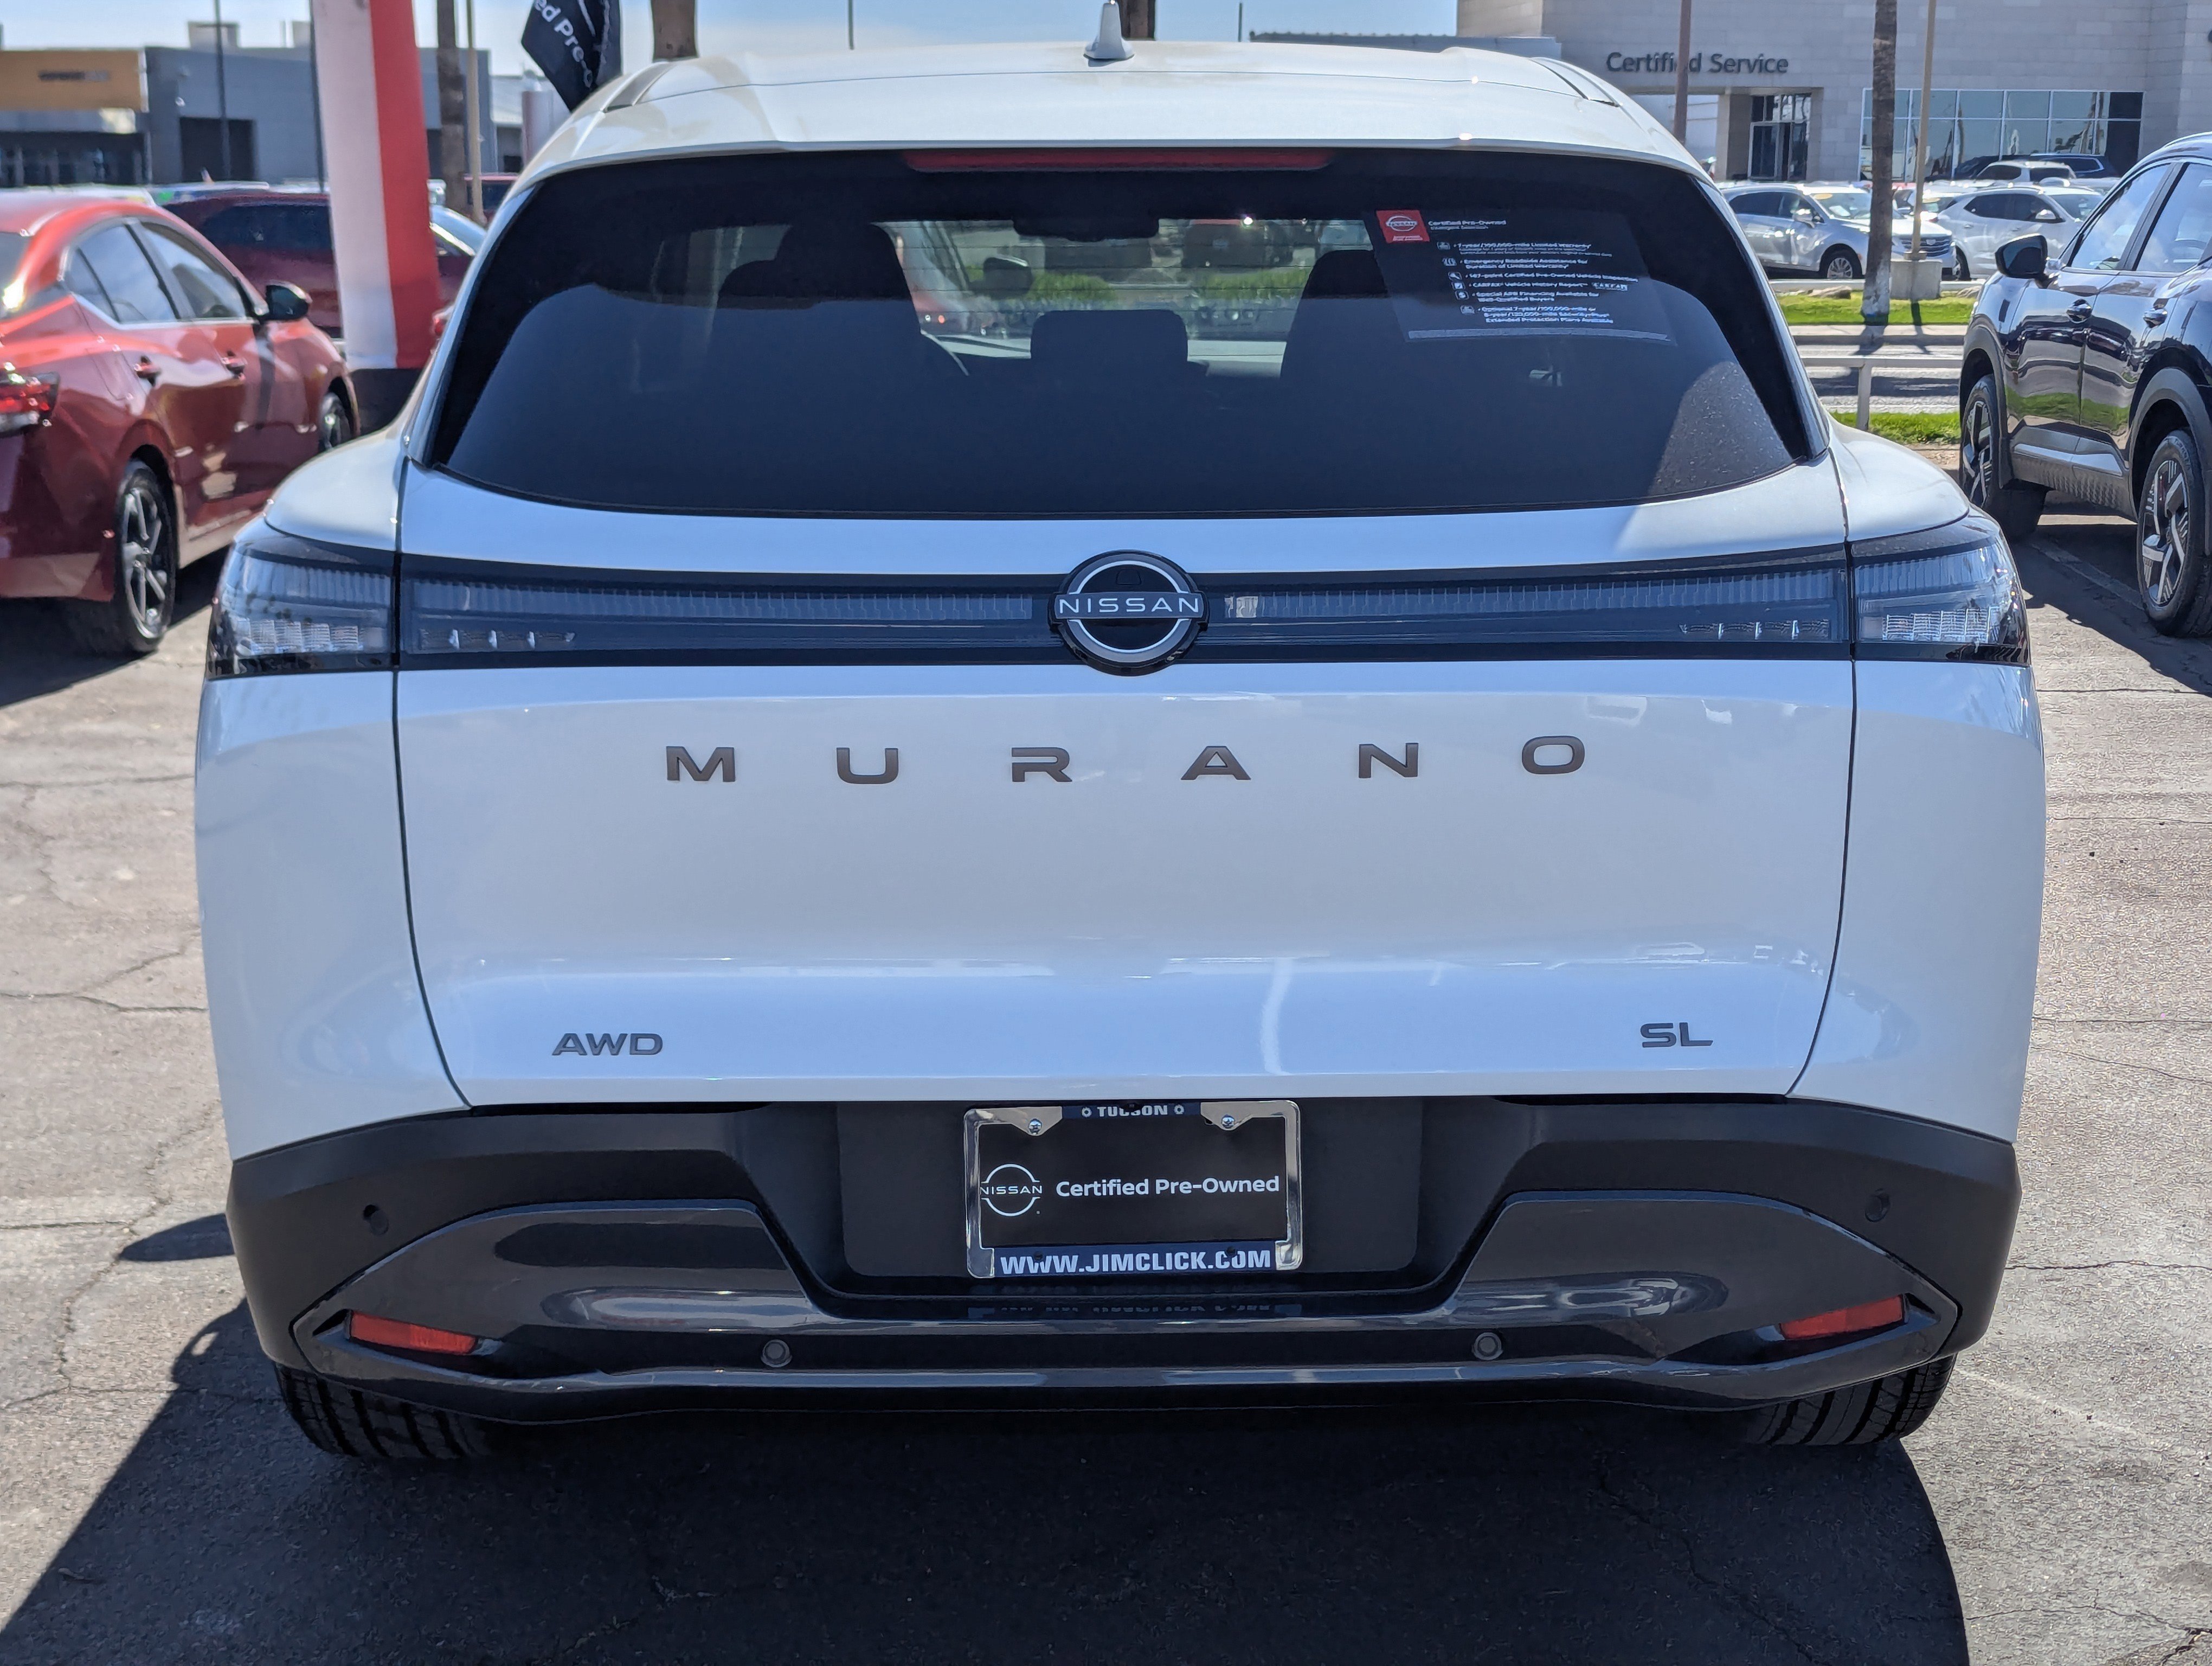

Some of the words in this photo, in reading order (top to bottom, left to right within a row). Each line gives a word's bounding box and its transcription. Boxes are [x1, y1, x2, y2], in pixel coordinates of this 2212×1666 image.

[1606, 52, 1702, 73] Certifid
[1709, 53, 1789, 73] Service
[1059, 597, 1199, 614] NISSAN
[665, 735, 1586, 785] MURANO
[552, 1033, 663, 1056] AWD
[1640, 1022, 1713, 1048] SL
[979, 1185, 1043, 1195] NISSAN
[1056, 1178, 1149, 1197] Certified
[1155, 1175, 1279, 1195] Pre-Owned
[1000, 1250, 1271, 1275] WWW.JIMCLICK.COM
